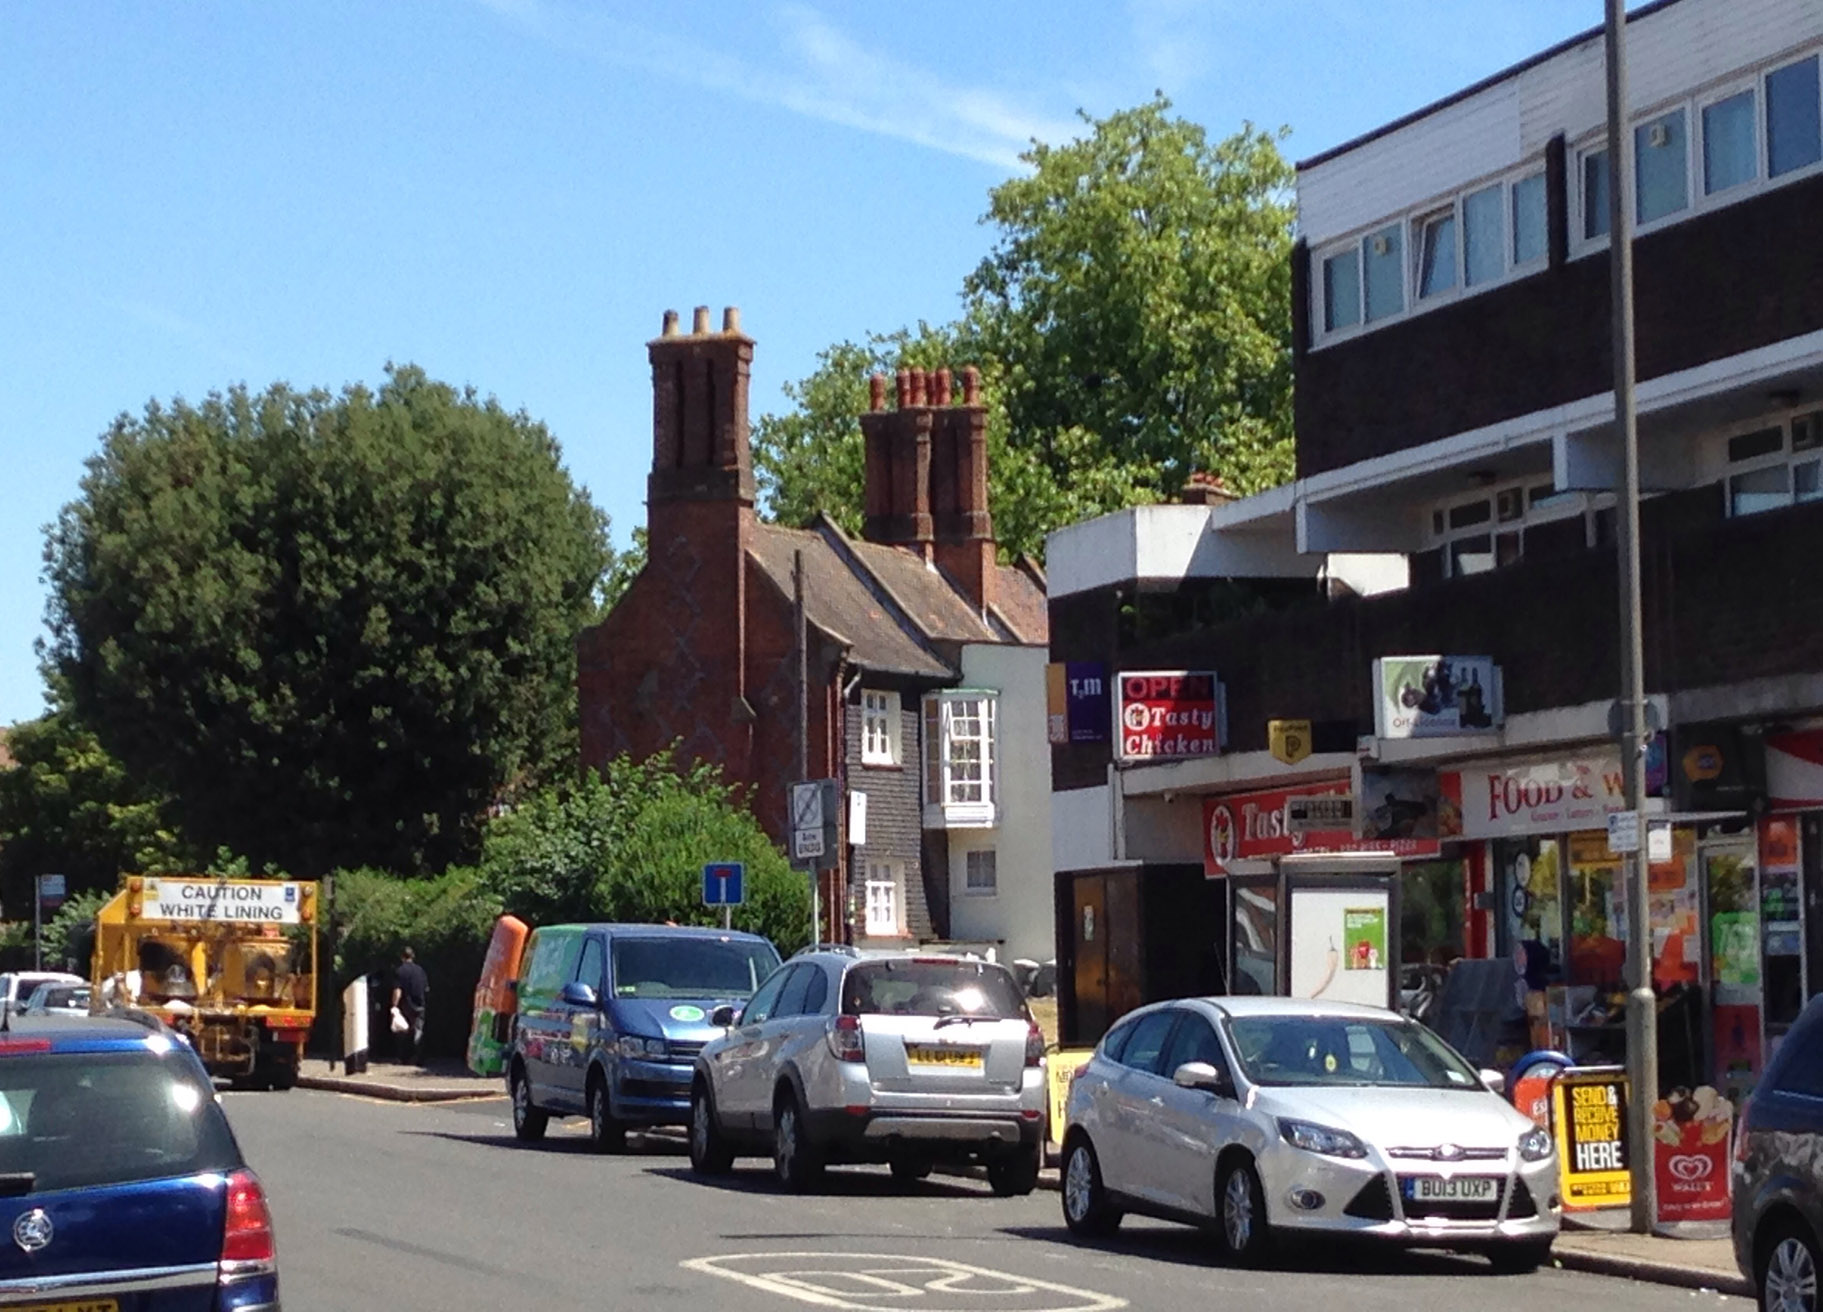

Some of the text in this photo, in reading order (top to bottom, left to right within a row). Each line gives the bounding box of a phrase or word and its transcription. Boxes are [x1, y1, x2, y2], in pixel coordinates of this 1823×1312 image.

[1151, 707, 1213, 730] Tasty
[1126, 733, 1214, 754] Chicken
[1488, 774, 1563, 821] FOOD
[181, 885, 262, 900] CAUTION
[160, 903, 283, 919] WHITE LINING
[1572, 1085, 1617, 1105] SEND &
[1574, 1105, 1618, 1123] RECEIVE
[1576, 1122, 1619, 1142] MONEY
[1576, 1141, 1623, 1170] HERE
[1461, 1180, 1491, 1197] UXP
